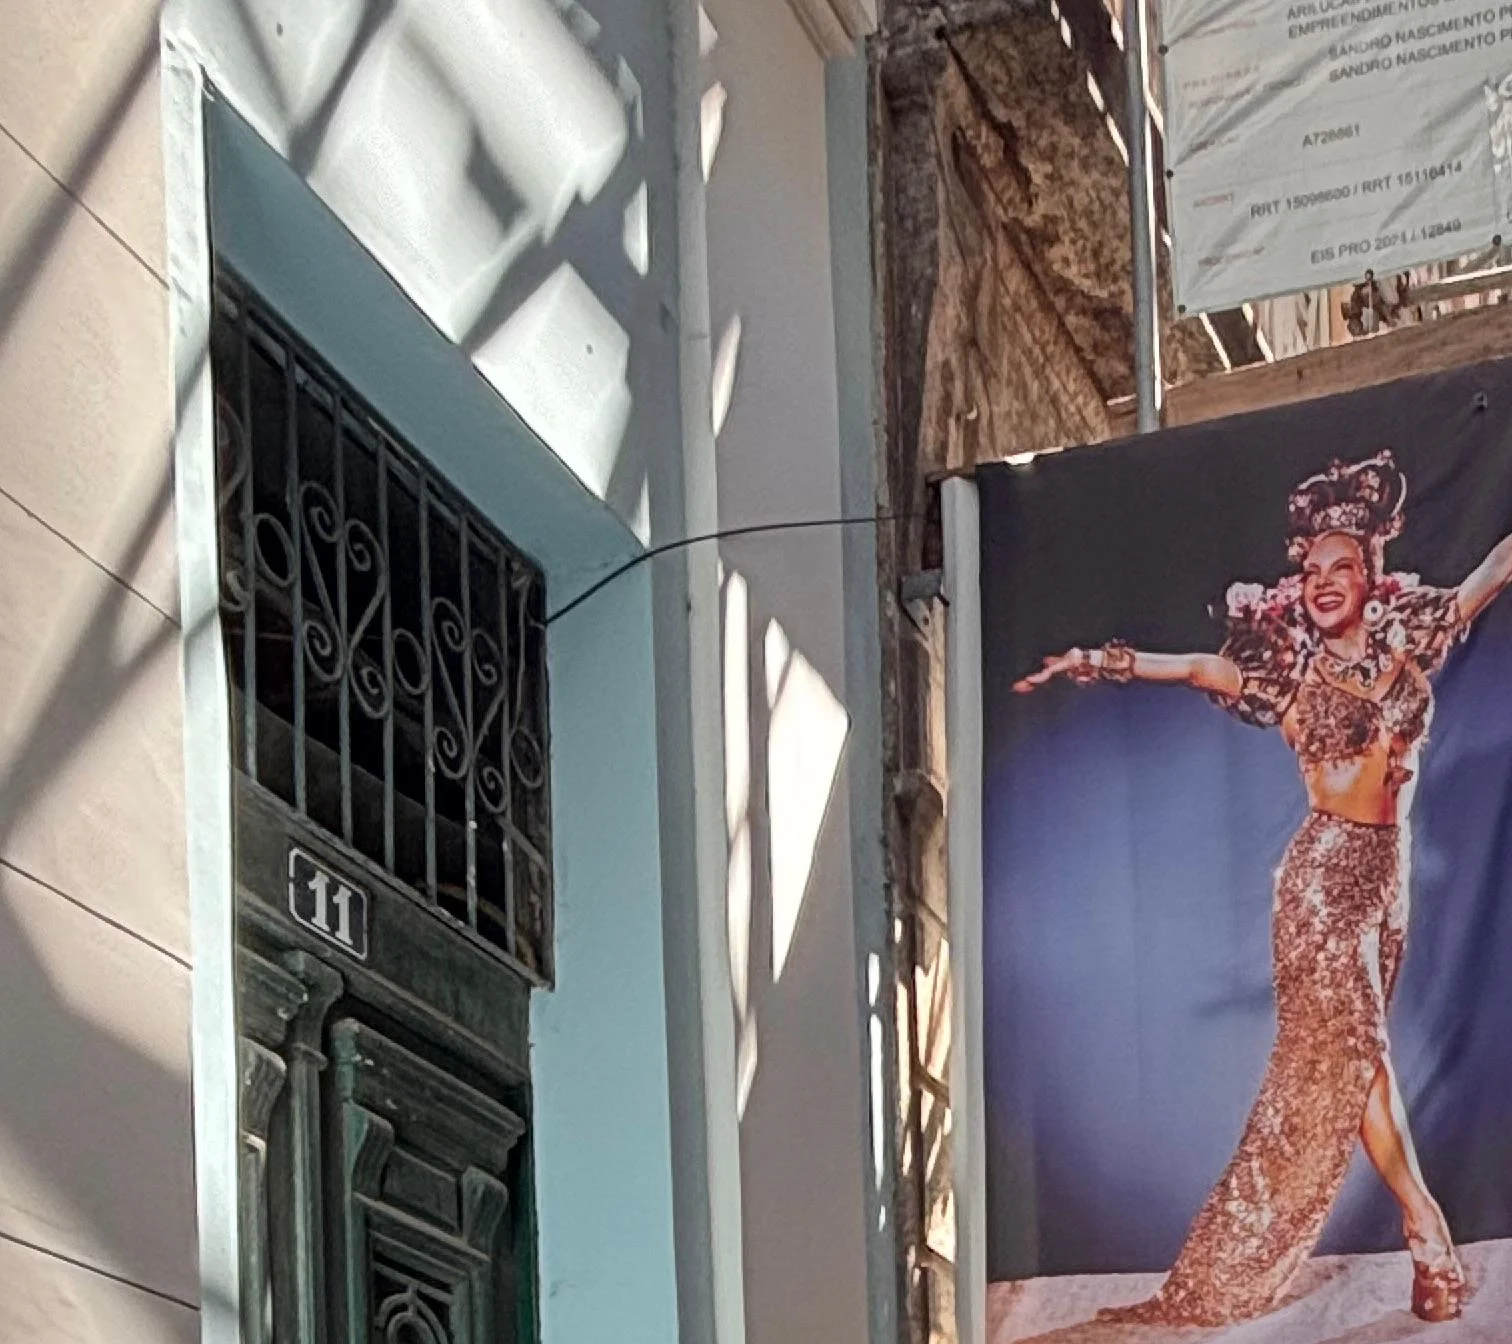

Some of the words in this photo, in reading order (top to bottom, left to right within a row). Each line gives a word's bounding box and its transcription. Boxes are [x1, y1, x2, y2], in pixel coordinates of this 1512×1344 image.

[1395, 8, 1496, 44] NASCIMENTO
[1328, 57, 1393, 82] SANDRO
[1396, 31, 1496, 67] NASCIMENTO
[1362, 174, 1393, 195] RRT
[1338, 239, 1371, 258] PRO
[307, 870, 353, 946] 11
